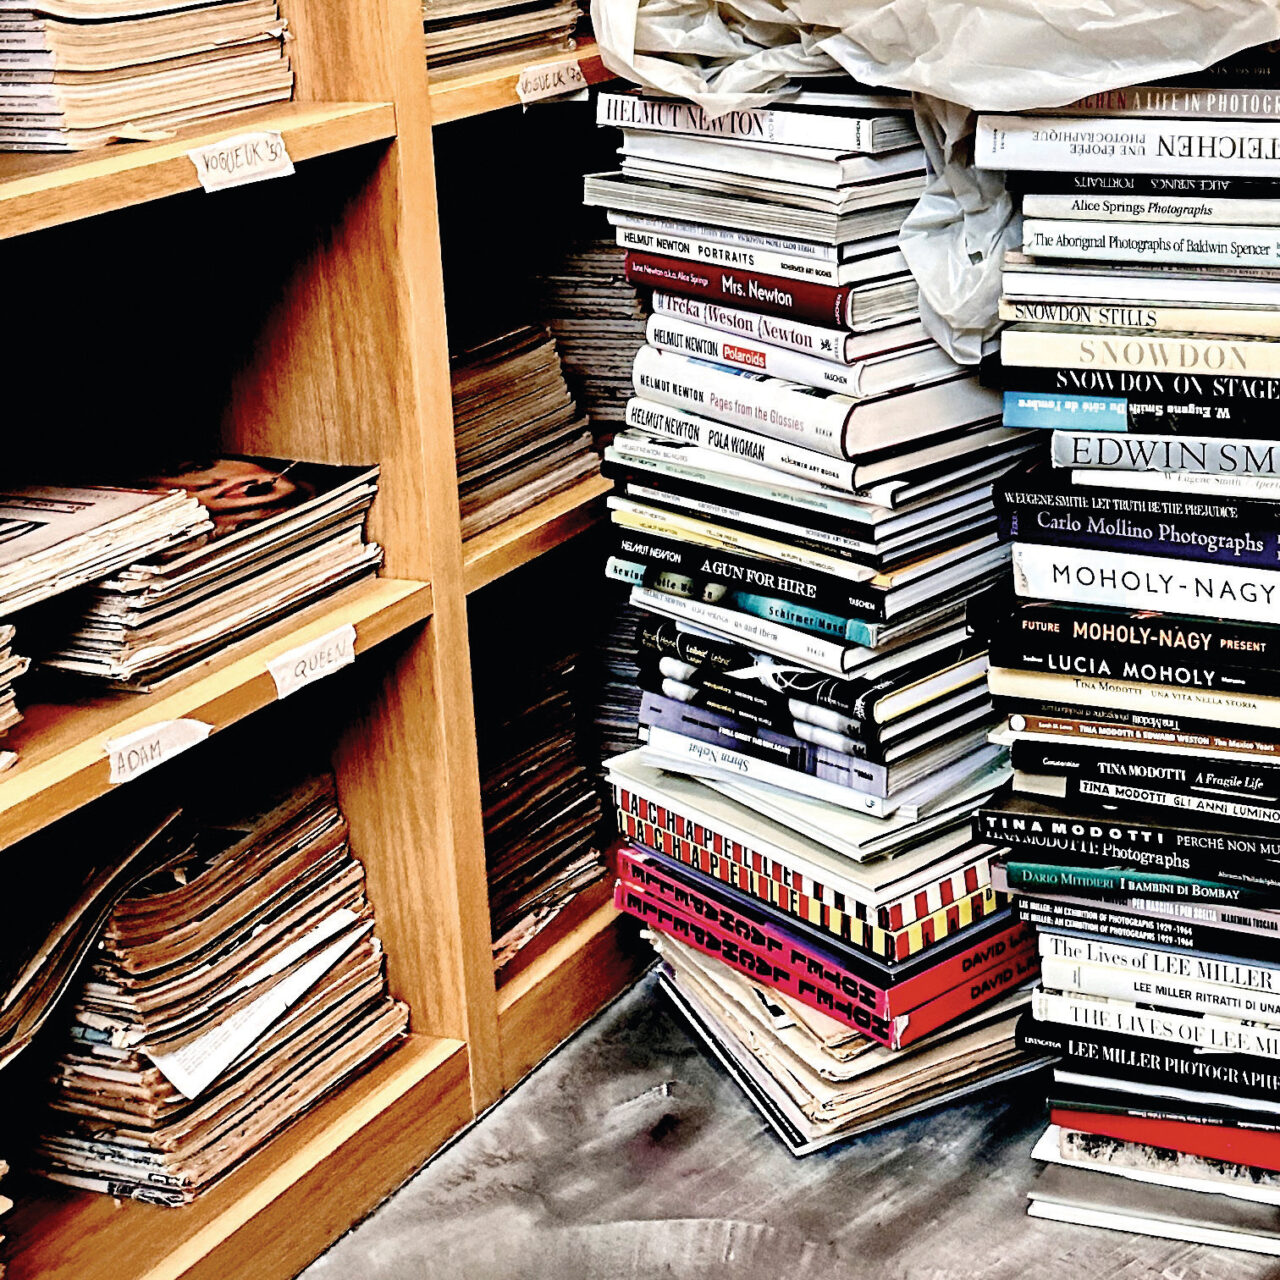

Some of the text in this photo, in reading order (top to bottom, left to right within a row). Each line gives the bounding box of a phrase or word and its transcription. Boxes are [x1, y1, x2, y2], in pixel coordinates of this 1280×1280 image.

[203, 147, 243, 173] VOGUE
[245, 143, 263, 166] UK
[1072, 199, 1100, 212] Alice
[1102, 200, 1145, 215] Springs
[1148, 201, 1213, 217] Photographs
[623, 231, 654, 248] HELMUT
[656, 237, 690, 254] NEWTON
[698, 244, 755, 265] PORTRAITS
[1034, 233, 1054, 248] The
[1056, 234, 1106, 251] Aboriginal
[1108, 237, 1170, 254] Photographs
[1172, 238, 1184, 253] of
[1187, 240, 1228, 255] Baldwin
[1230, 240, 1271, 258] Spencer
[721, 275, 793, 308] Mrs. Newton
[1015, 304, 1157, 328] SNOWDON STILLS
[653, 328, 848, 385] HELMUT NEWTON Polaroids TASCHEN
[1079, 341, 1248, 369] SNOWDON
[1055, 370, 1280, 400] SNOWDON ON STAGE
[630, 406, 765, 460] HELMUT NEWTON POLA WOMAN
[1071, 436, 1207, 470] EDWIN
[1037, 511, 1082, 532] Carlo
[1088, 516, 1153, 539] Mollino
[1158, 523, 1264, 553] Photographs
[701, 559, 817, 598] A GUN FOR HIRE
[1052, 563, 1276, 605] MOHOLY-NAGY
[1022, 621, 1266, 652] FUTURE MOHOLY-NAGY PRESENT
[293, 641, 349, 678] QUEEN
[1048, 654, 1215, 686] LUCIA MOHOLY
[116, 740, 163, 775] ADAM
[986, 816, 1040, 833] TINA
[1051, 822, 1165, 844] MODOTTI
[1176, 832, 1225, 850] PERCHÉ
[1227, 840, 1257, 853] NON
[1130, 880, 1174, 893] BAMBINI
[1176, 883, 1190, 895] DI
[1192, 884, 1240, 900] BOMBAY
[1050, 938, 1273, 990] The Lives of LEE MILLER
[1133, 982, 1152, 993] LEE
[1155, 985, 1193, 999] MILLER
[1195, 990, 1242, 1007] RITRATTI
[1245, 997, 1256, 1009] DI
[1067, 1039, 1100, 1060] LEE
[1103, 1044, 1162, 1070] MILLER
